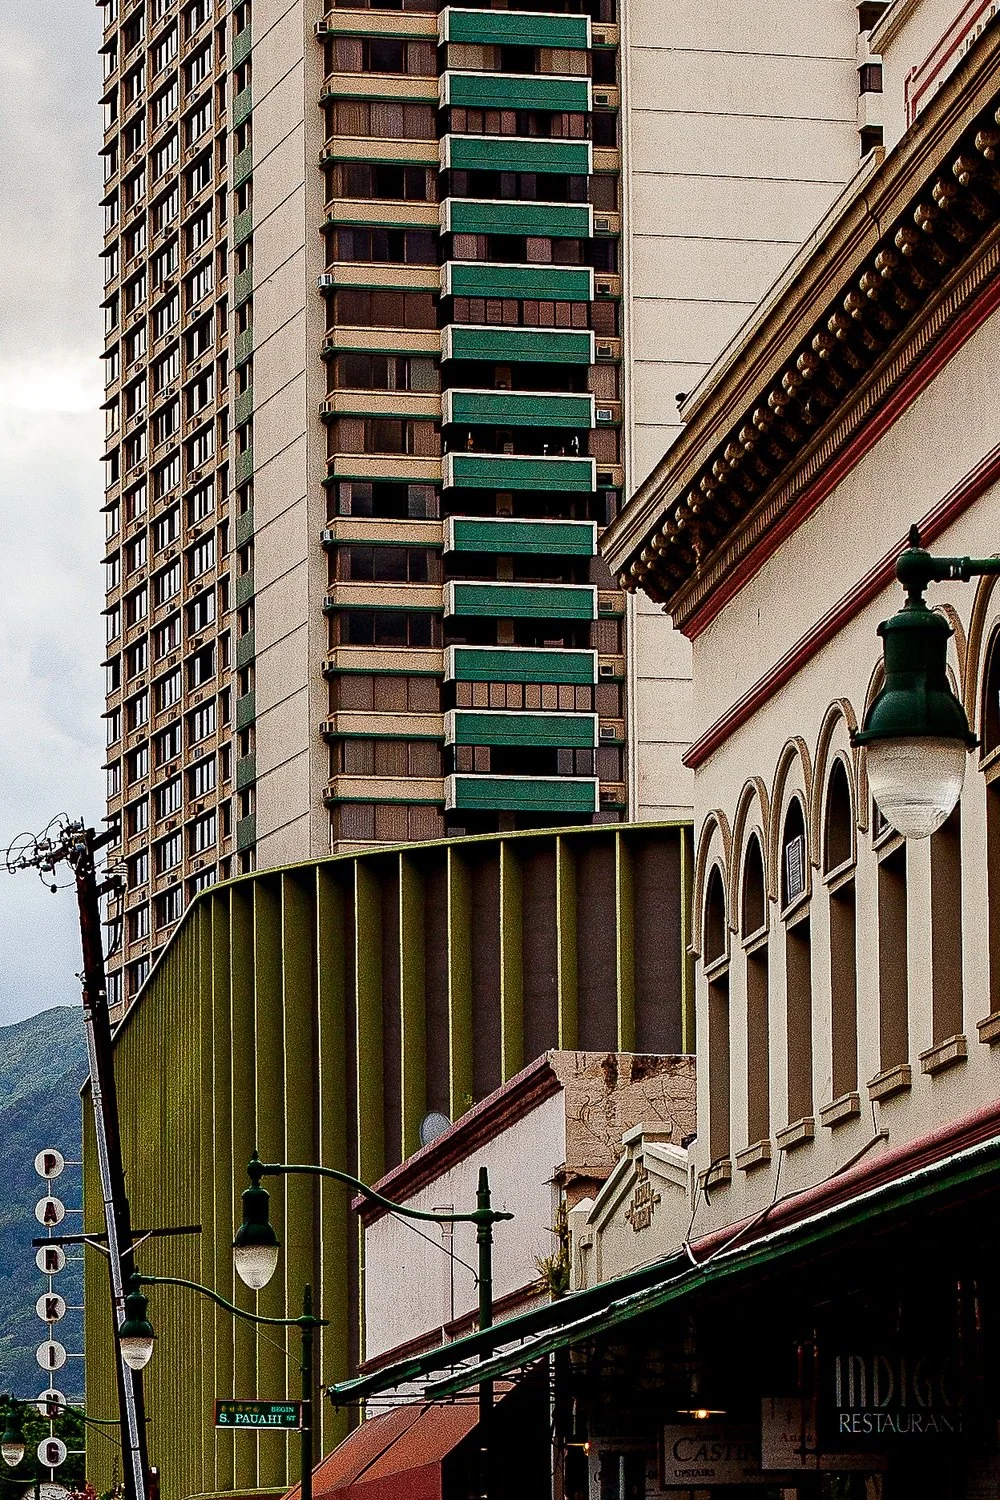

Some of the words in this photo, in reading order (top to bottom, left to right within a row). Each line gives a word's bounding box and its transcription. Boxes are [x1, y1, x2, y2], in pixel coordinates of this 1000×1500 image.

[219, 1413, 230, 1423] S.
[234, 1413, 282, 1424] PAUAHI
[838, 1411, 963, 1434] RESTAURANT
[674, 1468, 716, 1477] UPSTAIRS
